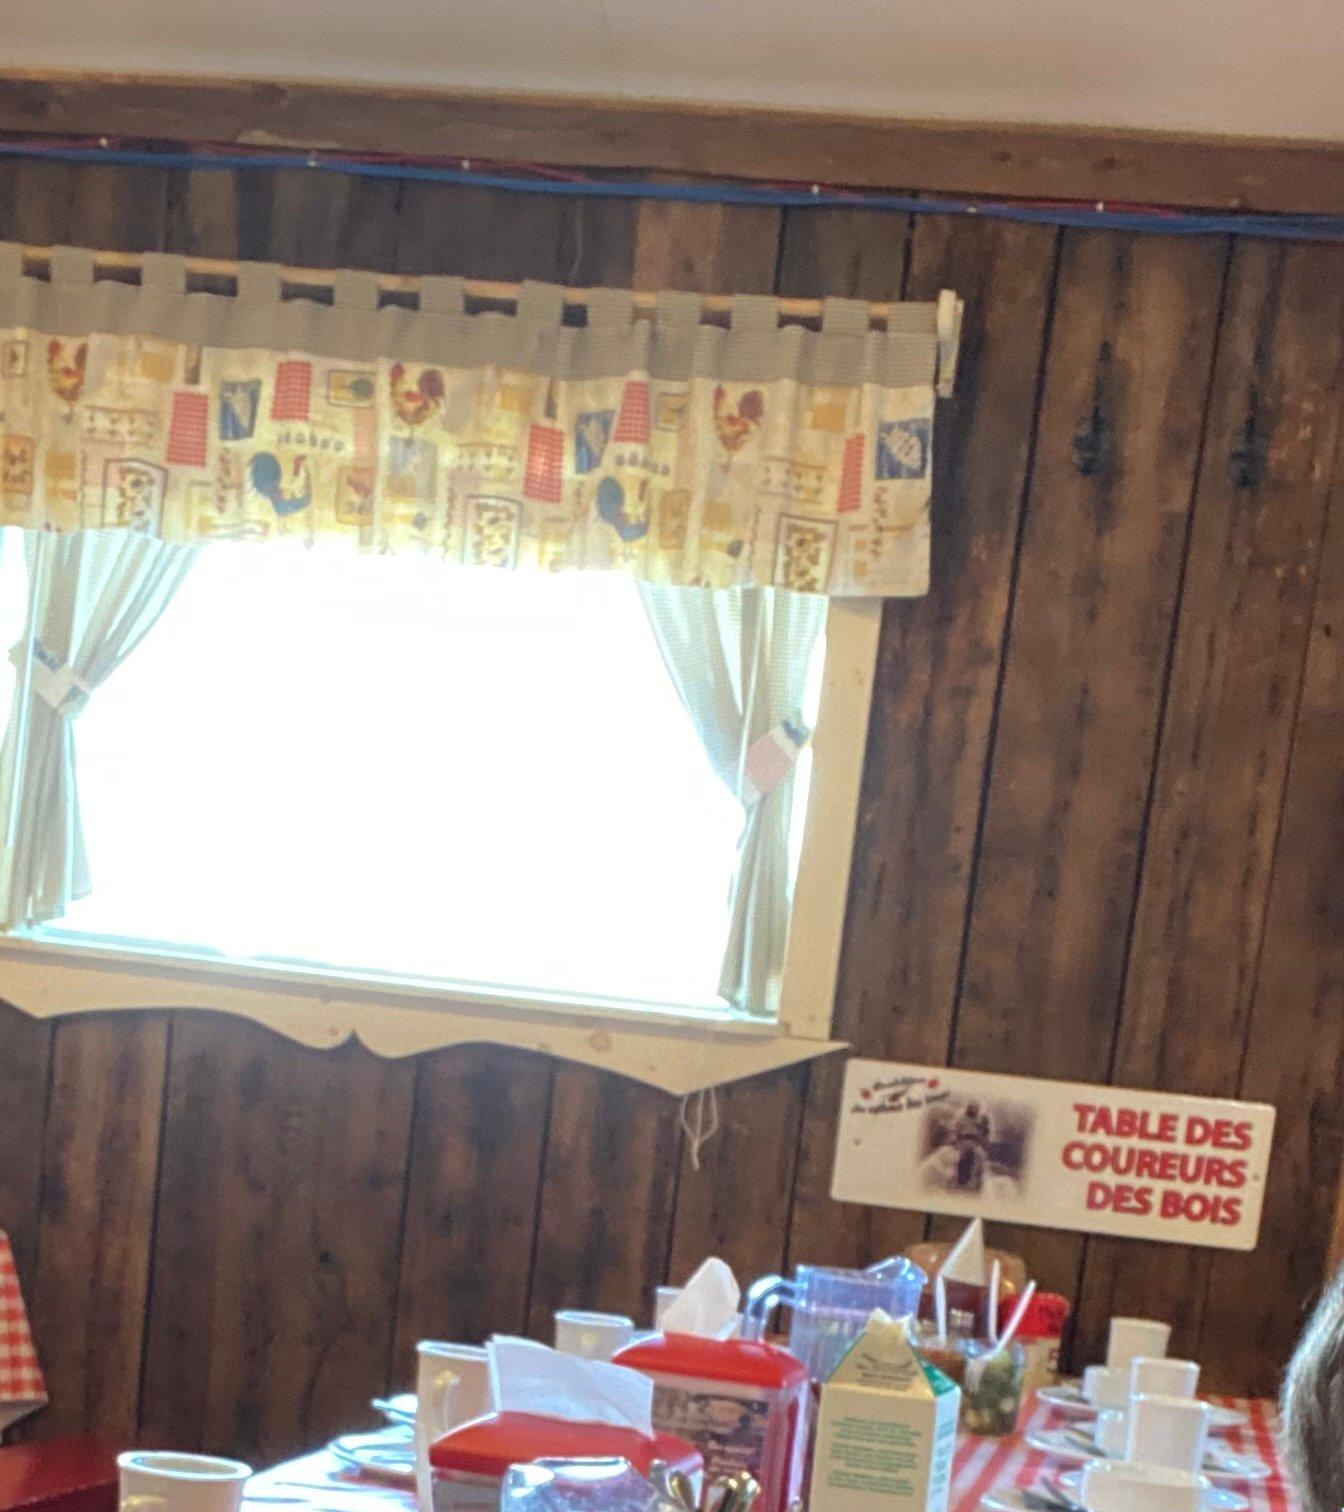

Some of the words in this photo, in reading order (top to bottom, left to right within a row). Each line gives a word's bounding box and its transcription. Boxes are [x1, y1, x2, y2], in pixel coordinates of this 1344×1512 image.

[1074, 1103, 1179, 1143] TABLE
[1185, 1115, 1252, 1151] DES
[1062, 1140, 1248, 1189] COUREURS
[1086, 1181, 1153, 1216] DES
[1160, 1189, 1242, 1226] BOIS
